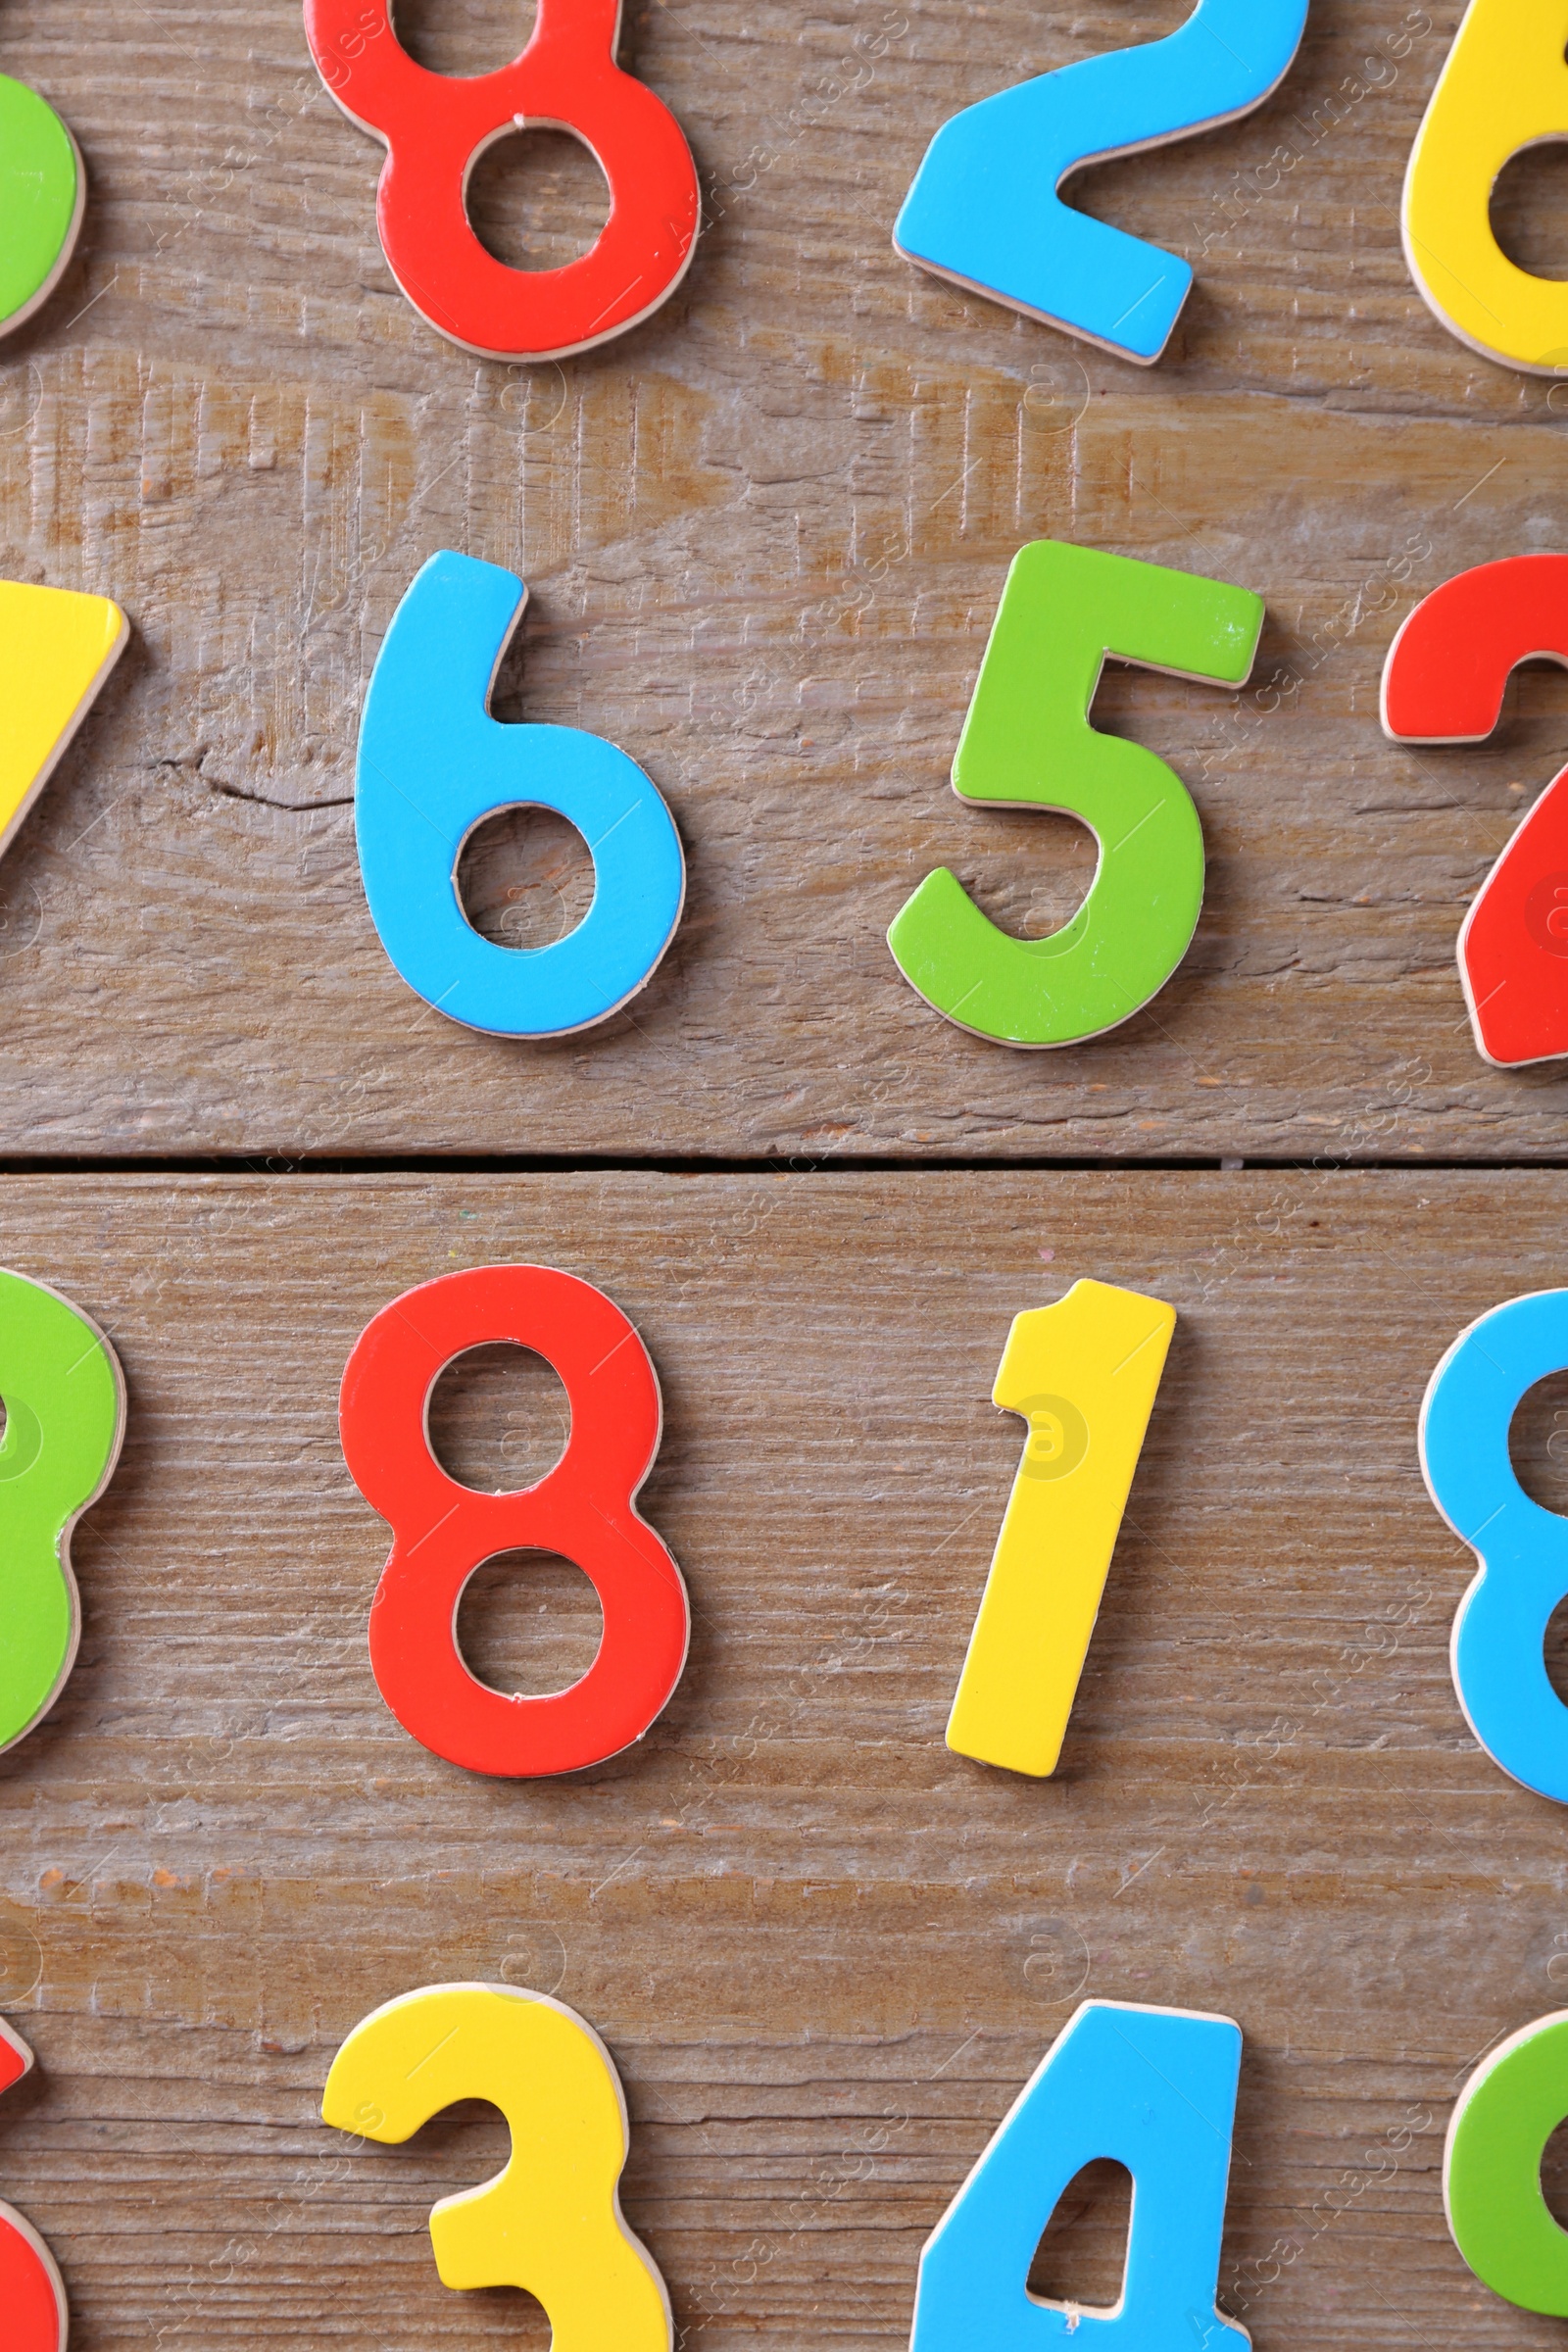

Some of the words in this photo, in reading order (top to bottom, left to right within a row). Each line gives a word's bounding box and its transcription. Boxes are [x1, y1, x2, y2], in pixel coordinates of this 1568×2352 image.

[304, 0, 702, 364] 8
[892, 0, 1309, 367] 2
[355, 549, 686, 1040] 6
[886, 539, 1266, 1049] 5
[338, 1263, 691, 1778] 8
[945, 1277, 1177, 1778] 1
[321, 1982, 674, 2352] 3
[909, 1998, 1253, 2352] 4
